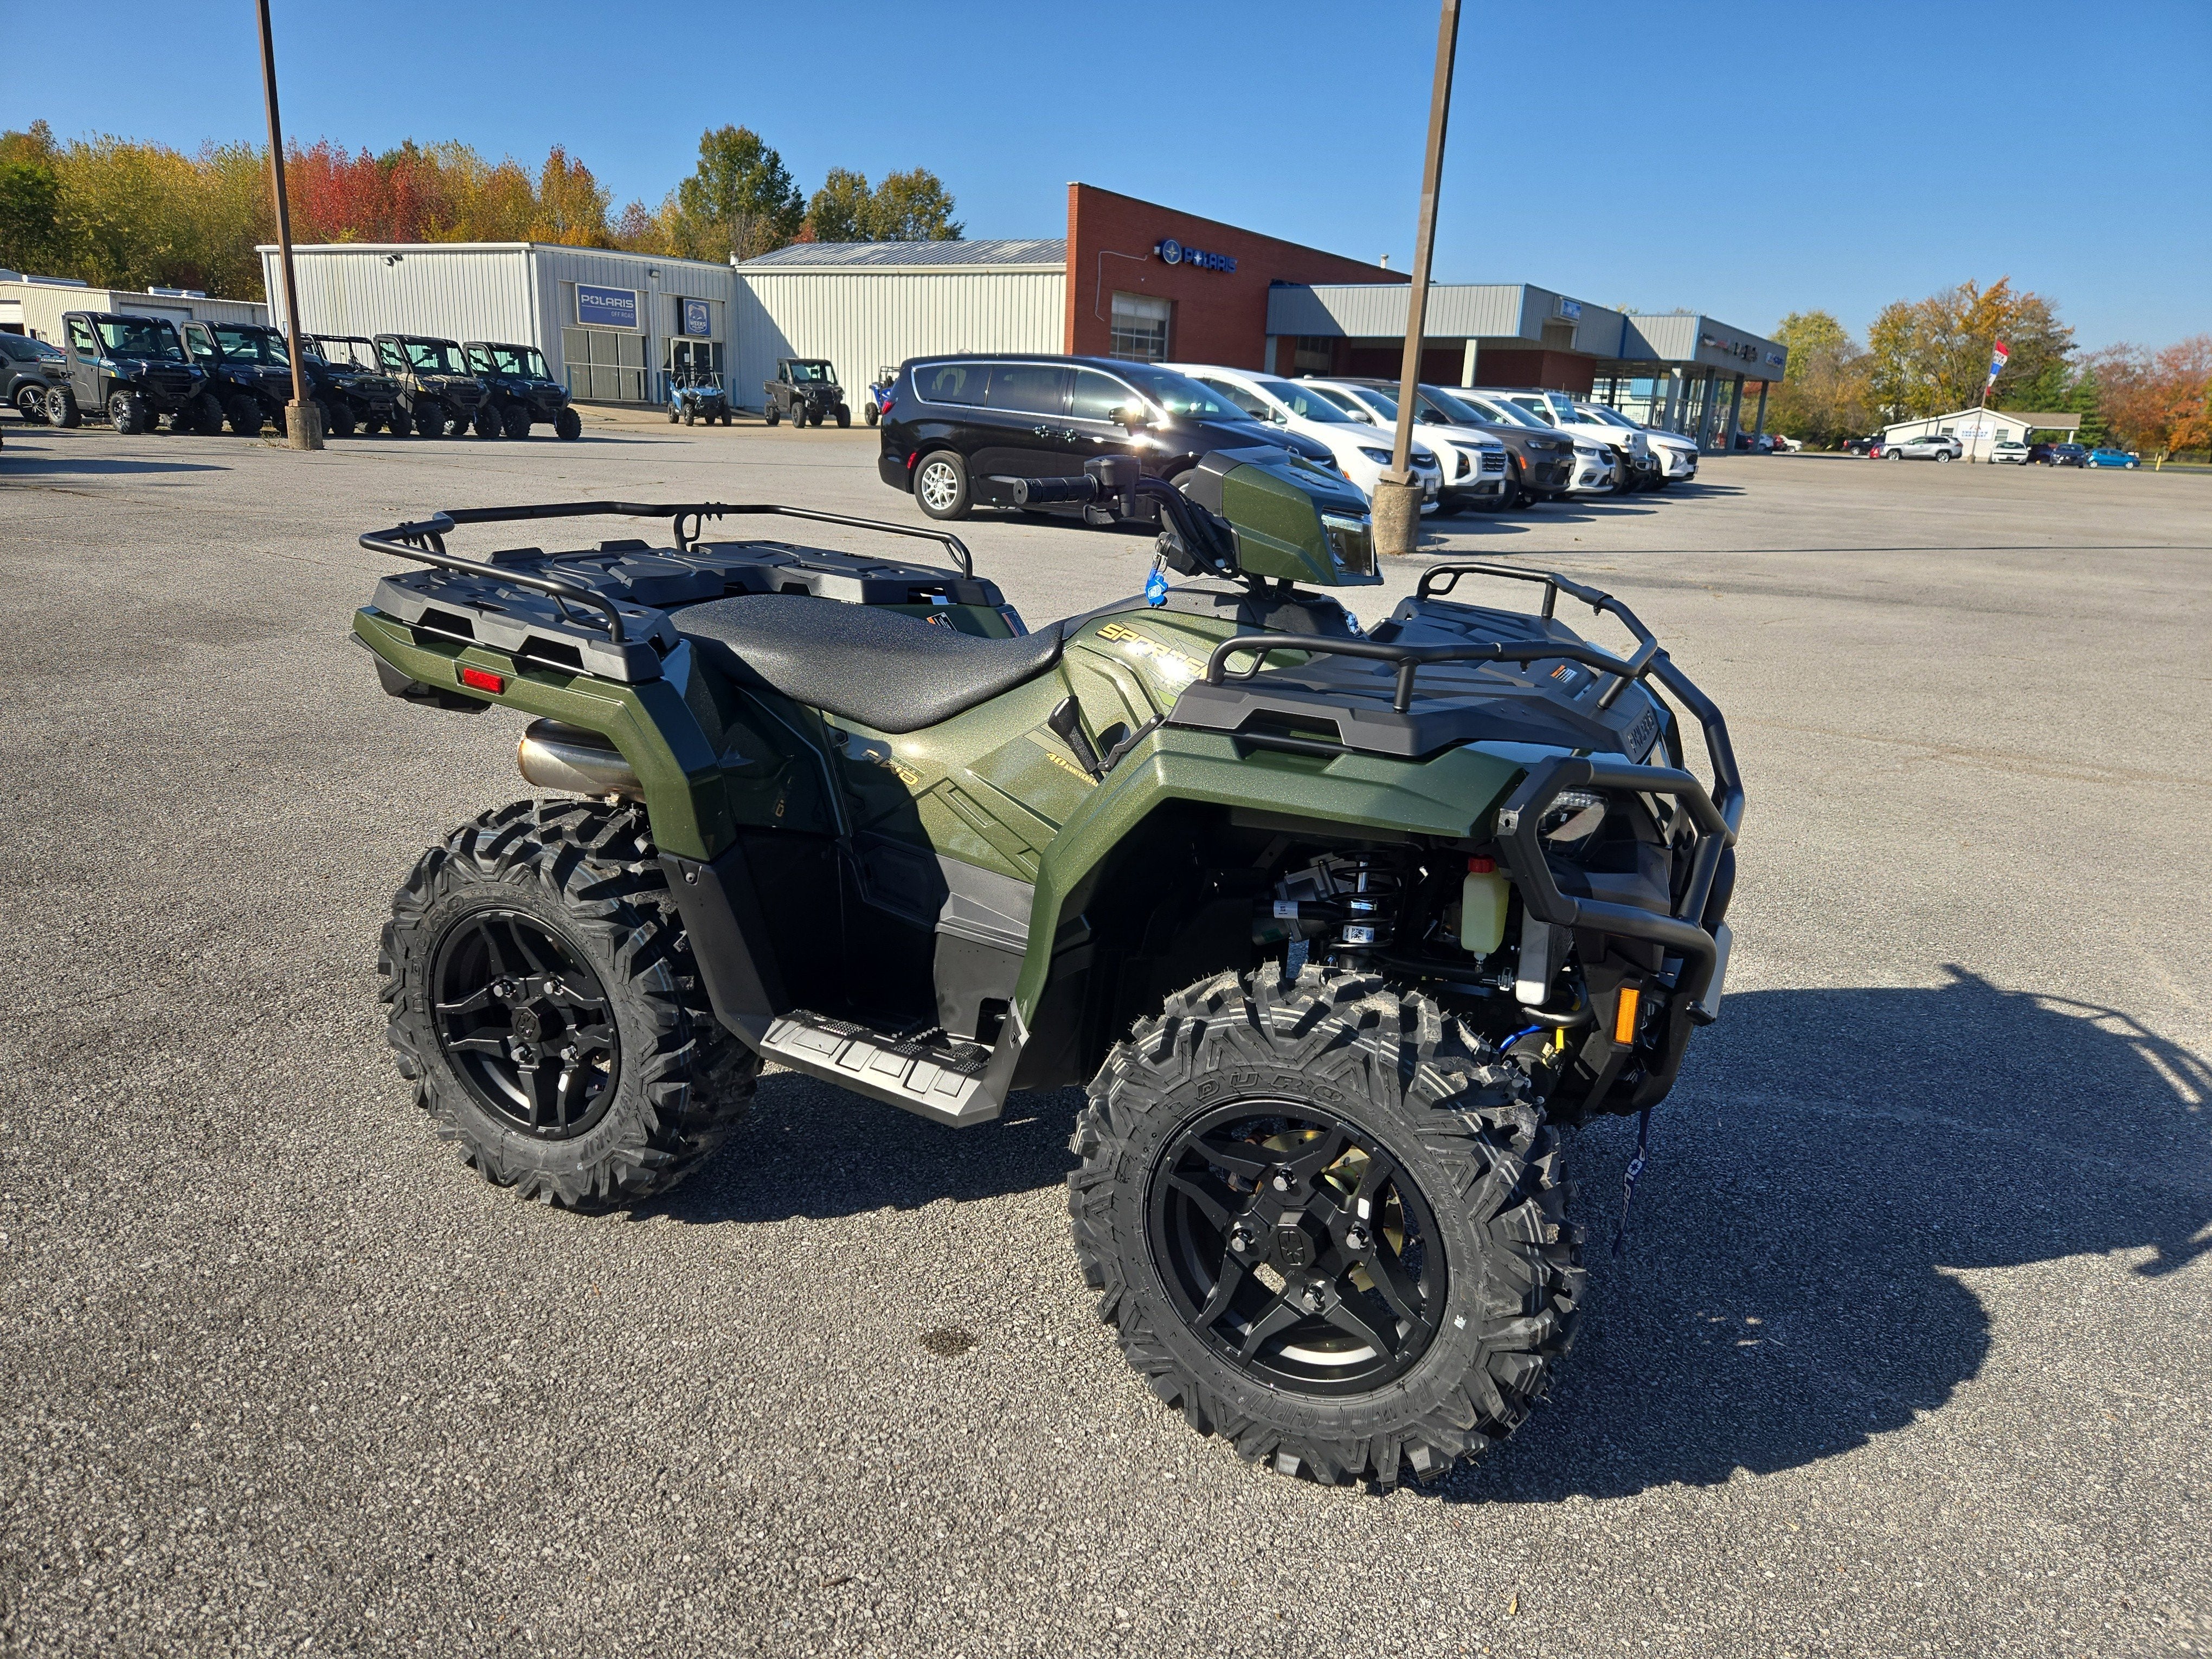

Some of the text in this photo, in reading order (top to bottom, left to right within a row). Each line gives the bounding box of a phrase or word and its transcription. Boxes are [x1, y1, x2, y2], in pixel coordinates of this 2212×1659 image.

[1184, 247, 1238, 274] POLARIS
[581, 294, 634, 308] POLARIS
[860, 748, 919, 786] AWD
[1045, 753, 1068, 767] 40
[1196, 1071, 1344, 1102] DURO
[1335, 1375, 1435, 1433] POWER
